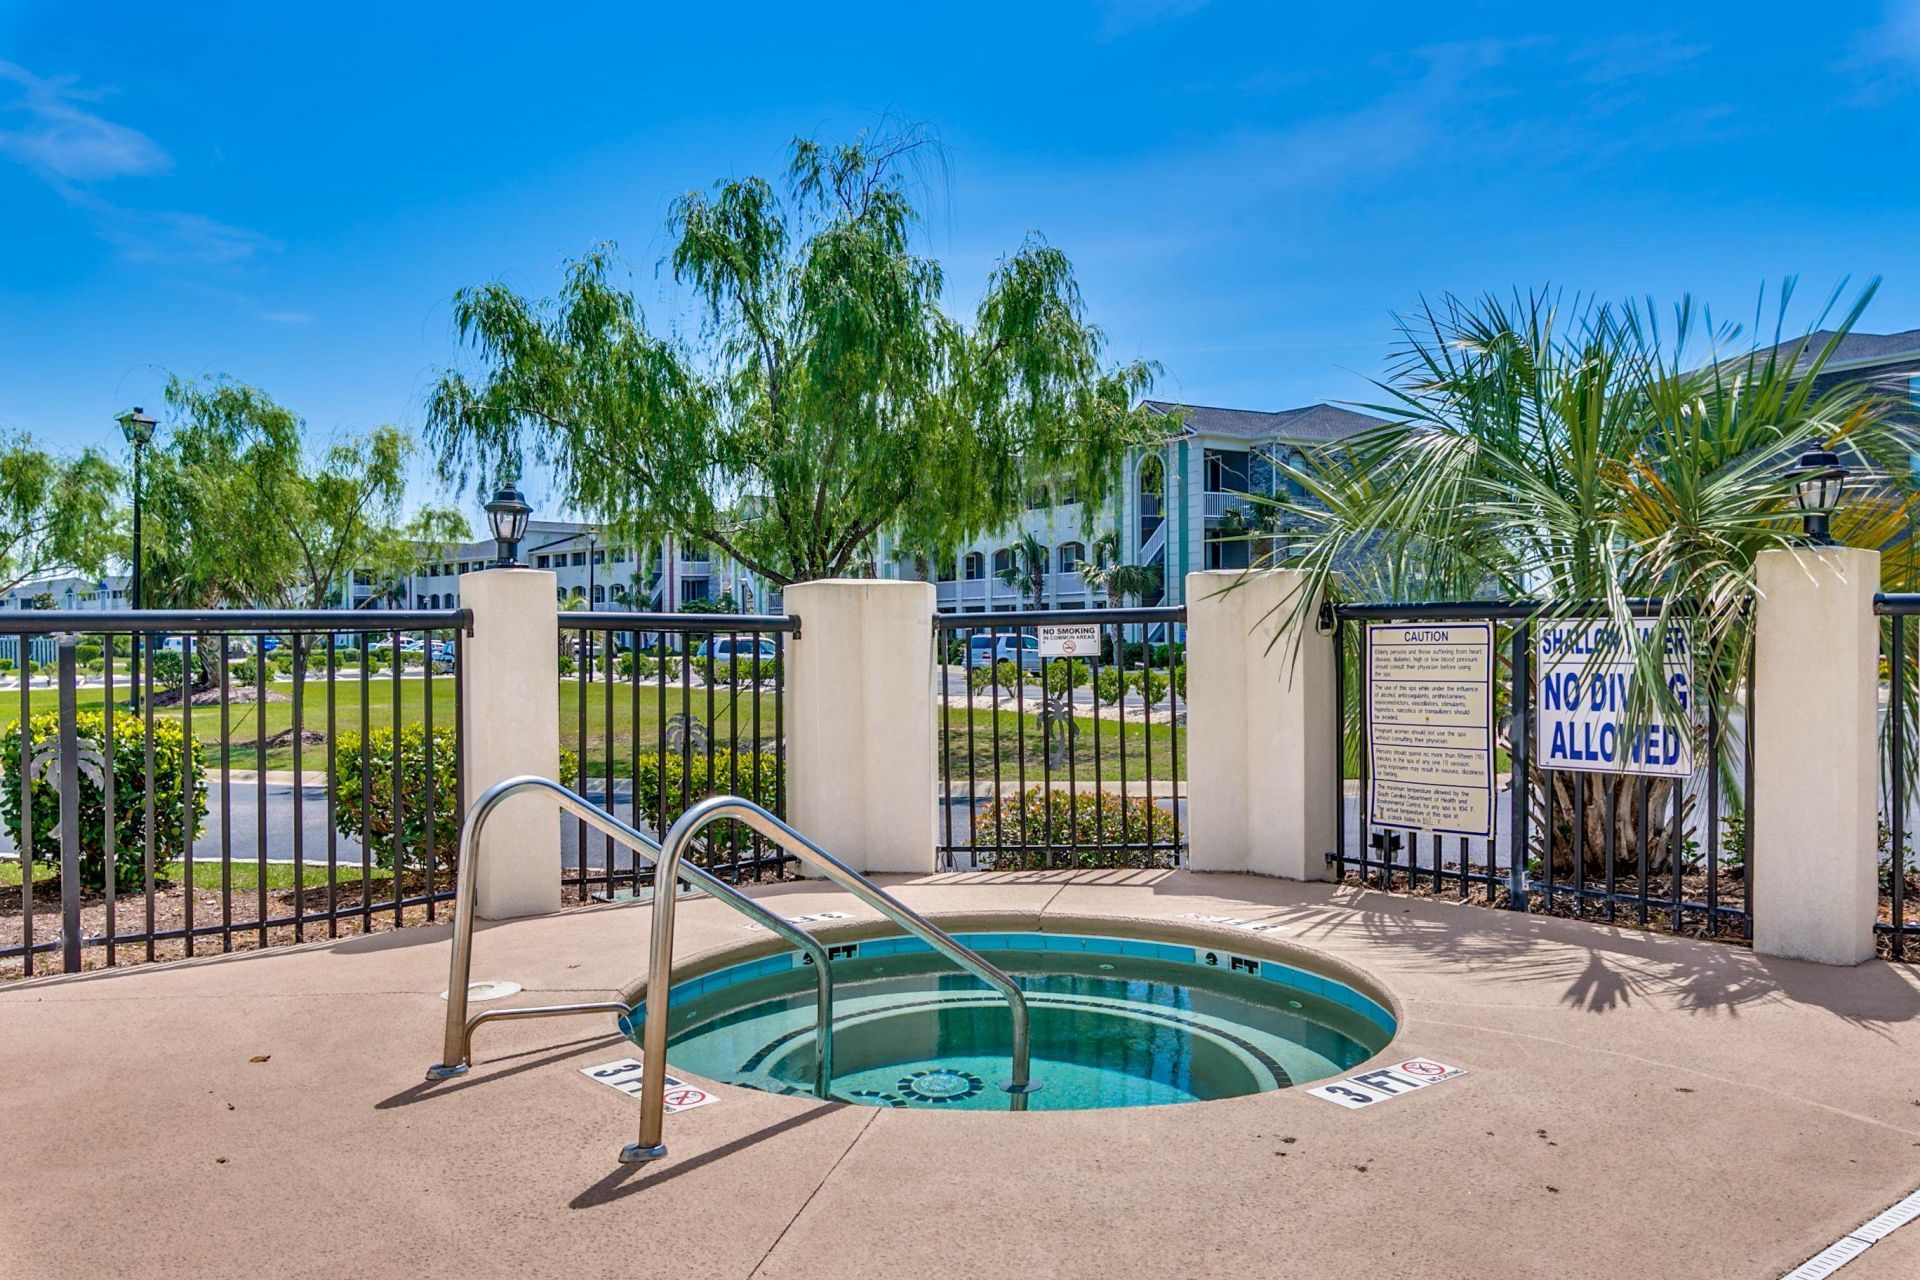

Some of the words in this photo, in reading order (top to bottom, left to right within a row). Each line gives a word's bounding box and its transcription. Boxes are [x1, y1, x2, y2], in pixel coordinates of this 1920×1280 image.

[1404, 631, 1448, 642] CAUTION
[1545, 672, 1580, 711] NO
[1591, 672, 1687, 713] DIVG
[828, 944, 857, 960] FT
[1231, 957, 1258, 974] FT
[594, 1064, 641, 1078] 3
[1325, 1086, 1372, 1103] 3
[1352, 1070, 1419, 1093] FT
